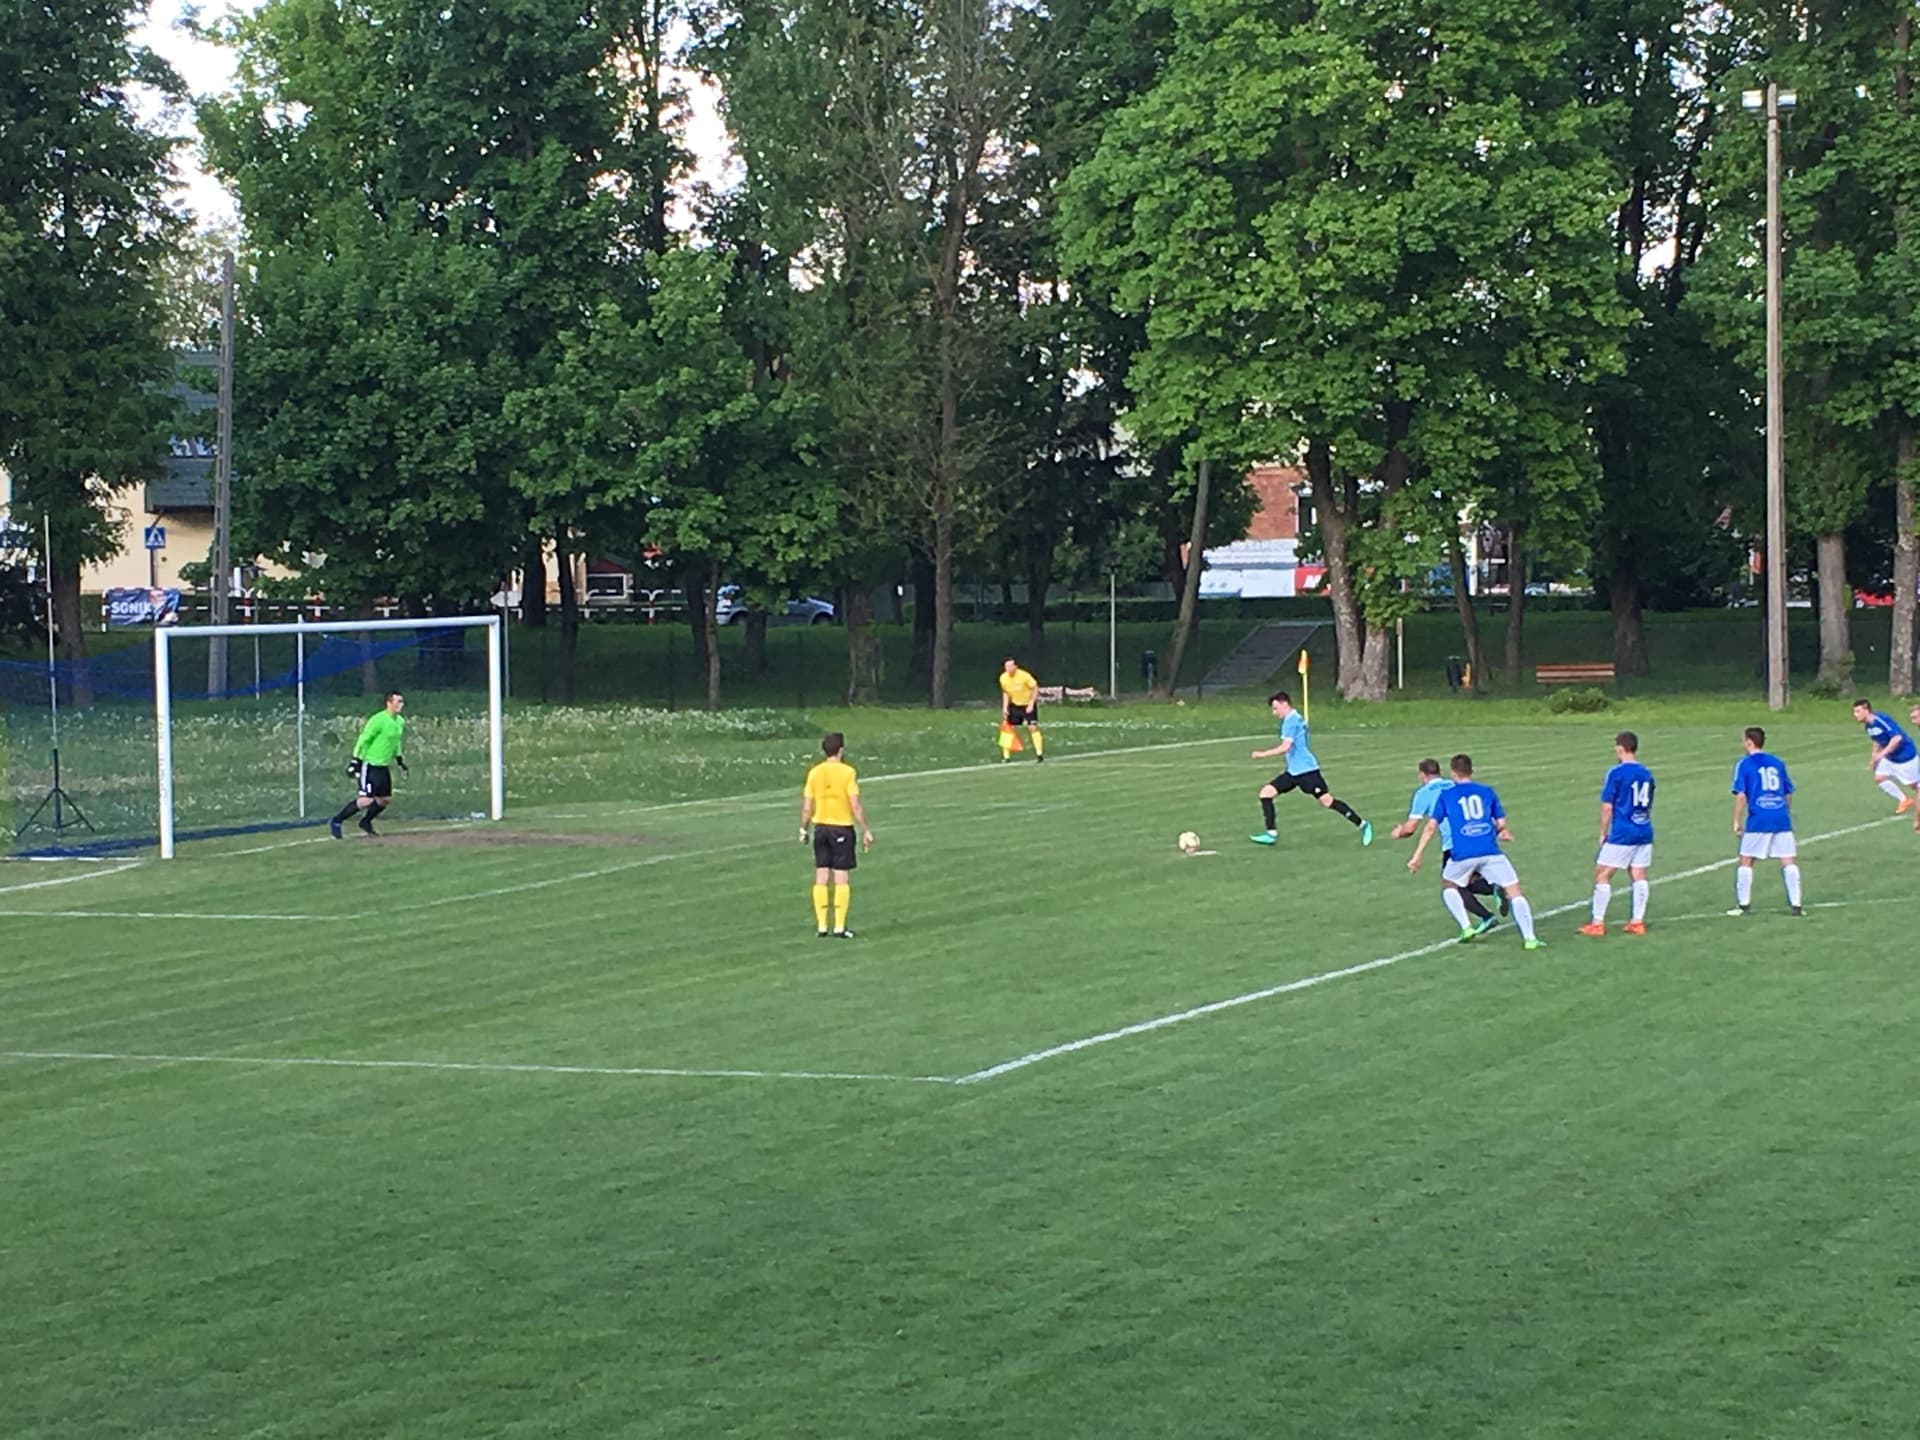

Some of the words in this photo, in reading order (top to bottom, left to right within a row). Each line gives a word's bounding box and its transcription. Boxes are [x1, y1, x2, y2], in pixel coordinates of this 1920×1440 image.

[1757, 766, 1780, 791] 16
[1630, 780, 1650, 807] 14
[1457, 794, 1484, 820] 10
